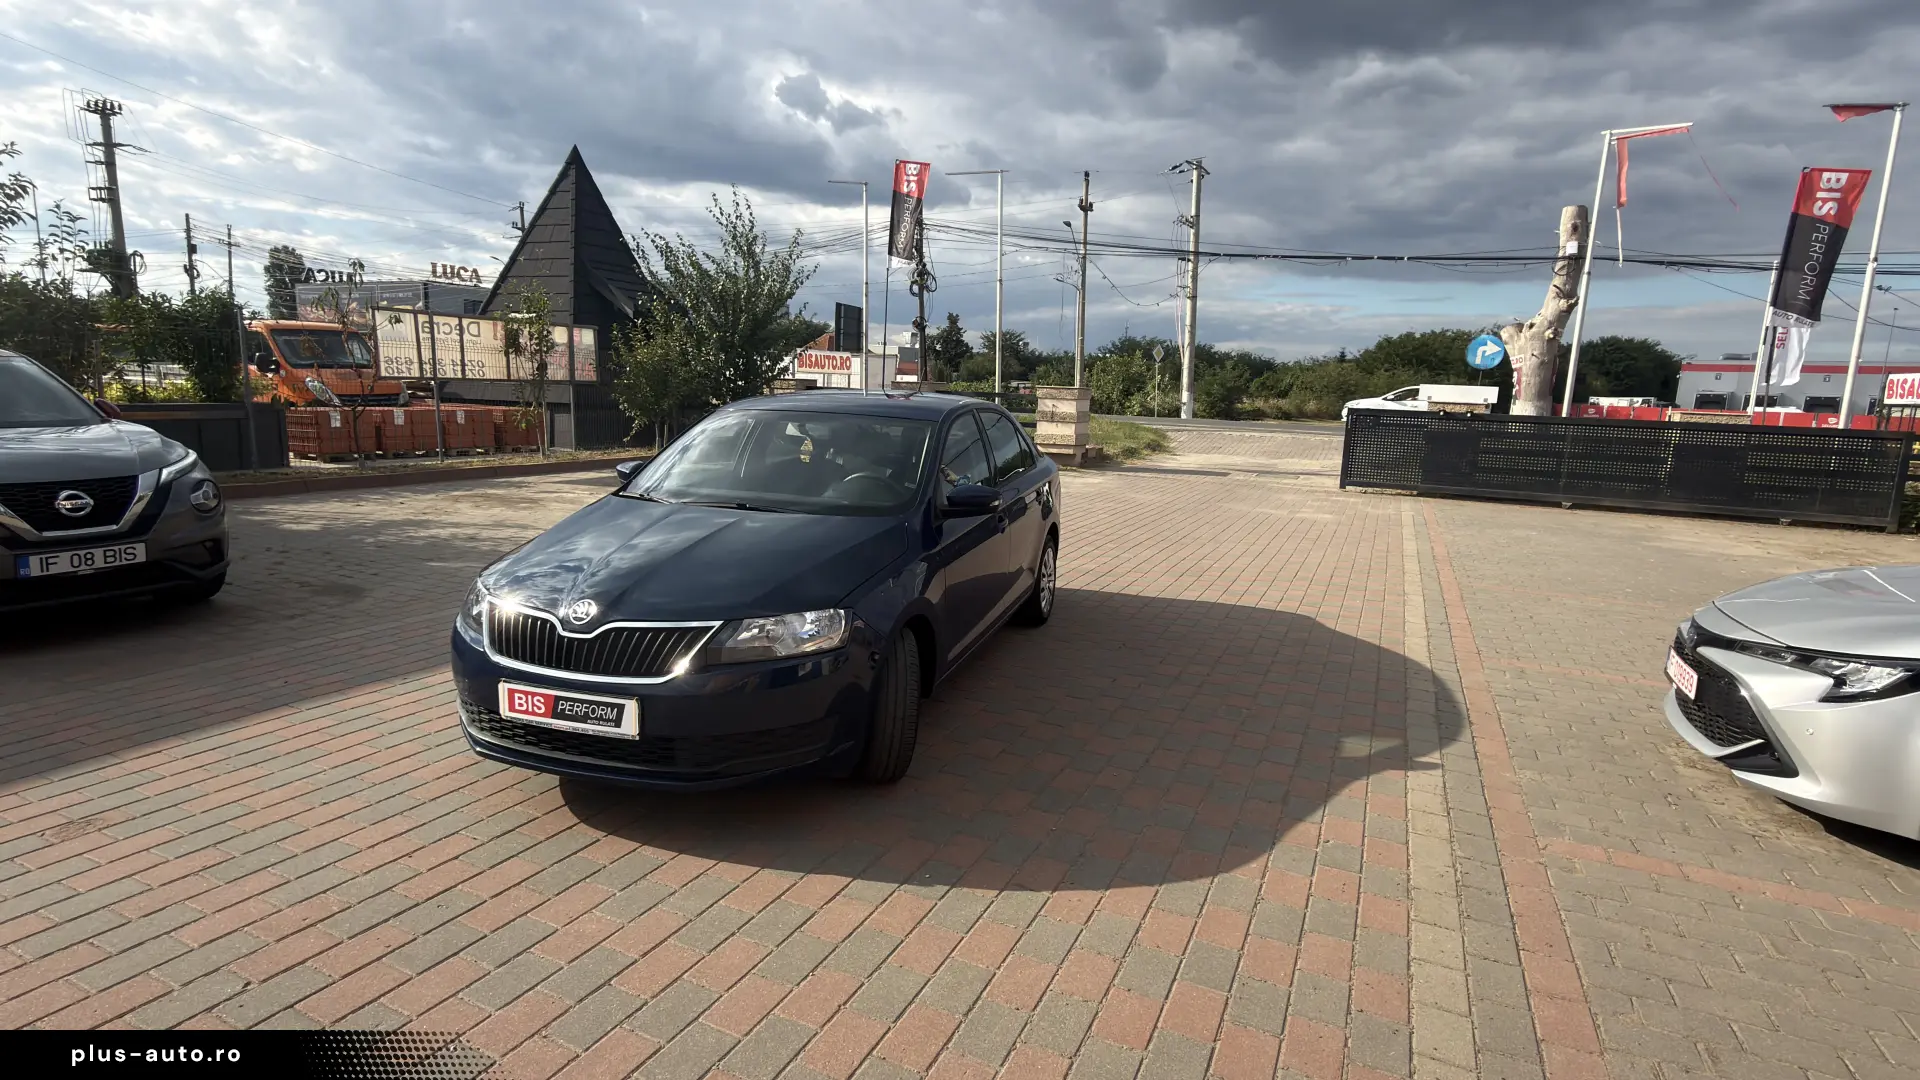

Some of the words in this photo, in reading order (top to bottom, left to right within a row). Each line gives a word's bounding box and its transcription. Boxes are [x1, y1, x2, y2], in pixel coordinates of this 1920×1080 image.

[903, 163, 920, 192] BIS
[1813, 171, 1849, 216] BIS
[898, 196, 913, 248] PERFORM
[430, 261, 482, 284] LUCA
[1797, 223, 1829, 300] PERFORM
[1772, 310, 1794, 321] AUTO
[798, 352, 852, 371] BISAUTO.RO
[39, 555, 60, 573] IF
[70, 552, 95, 568] 08
[103, 546, 137, 565] BIS
[514, 693, 546, 713] BIS
[557, 700, 618, 720] PERFORM
